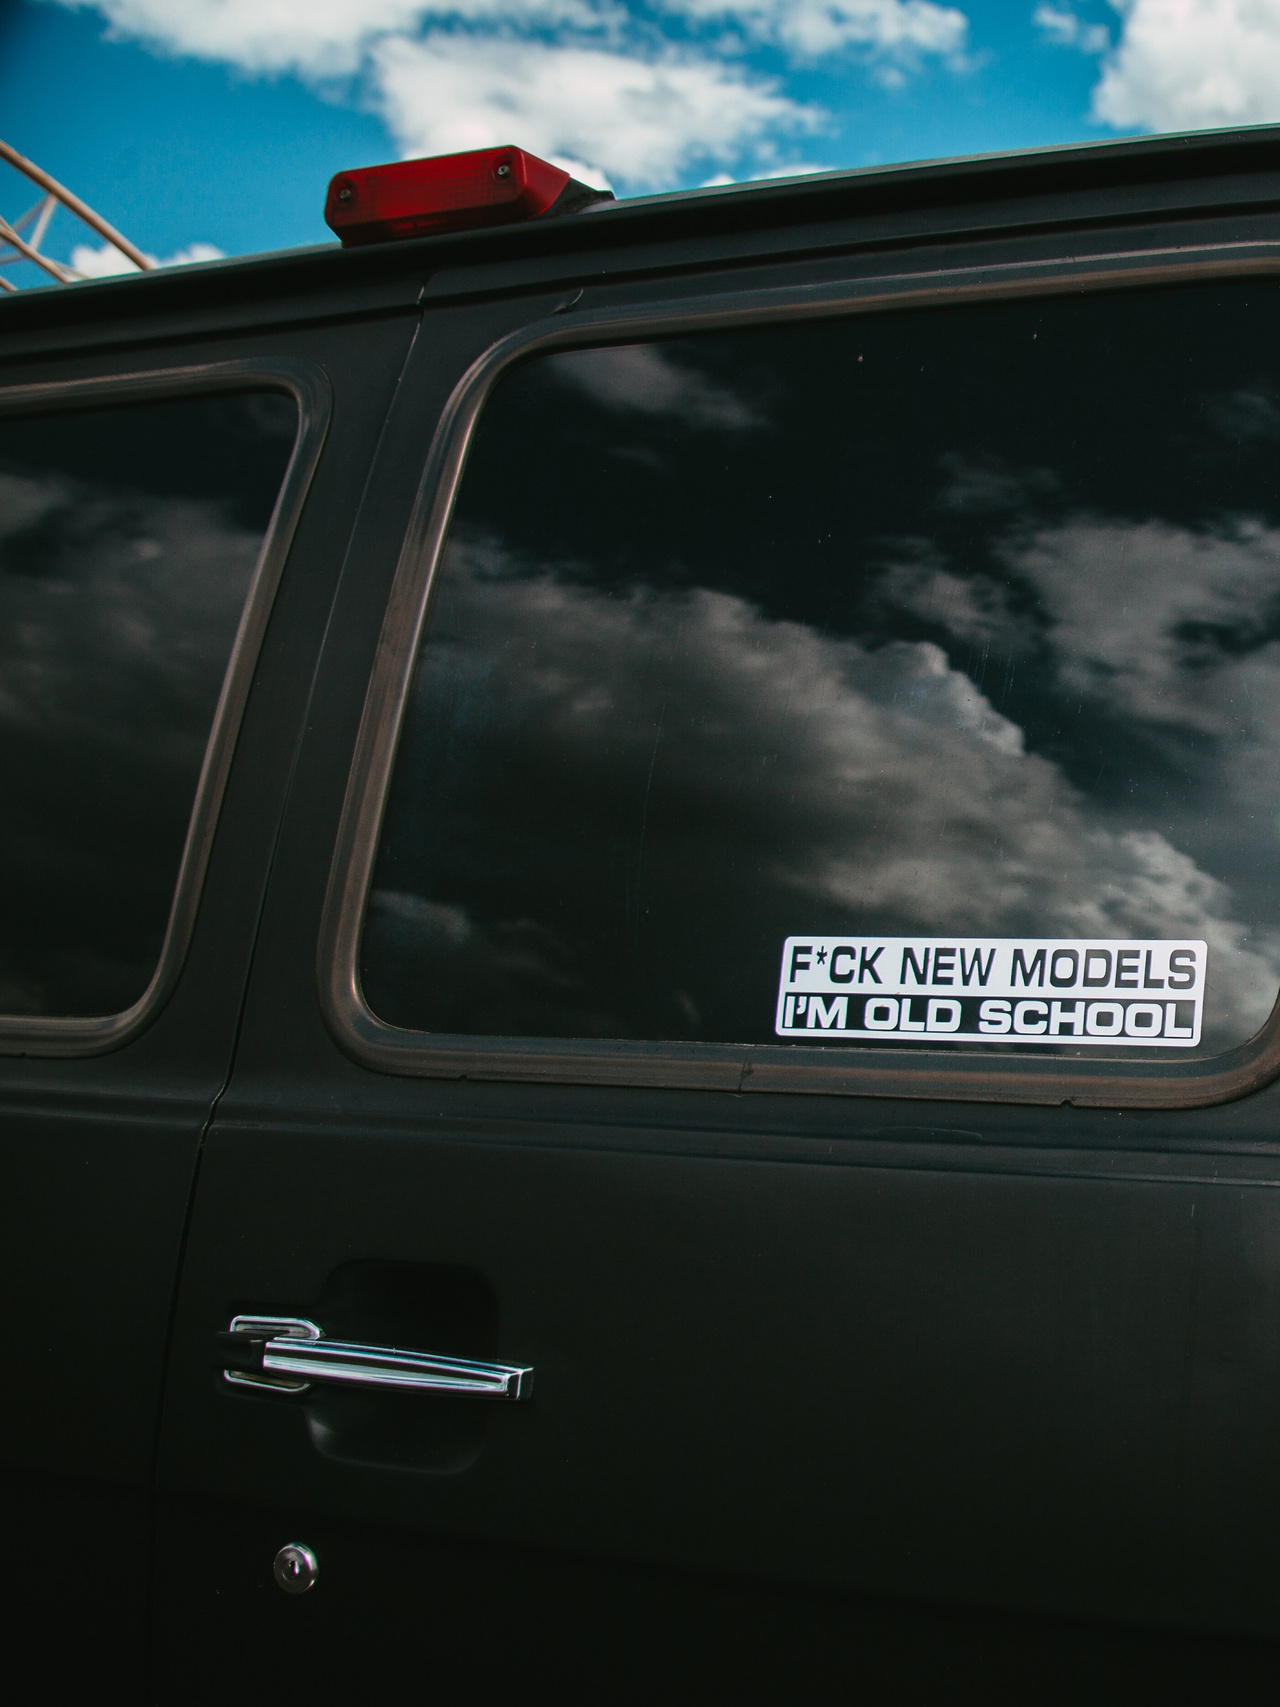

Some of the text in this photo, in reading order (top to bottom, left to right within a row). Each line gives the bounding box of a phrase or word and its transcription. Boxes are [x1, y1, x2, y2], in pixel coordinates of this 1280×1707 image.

[900, 947, 997, 987] NEW
[1010, 948, 1197, 990] MODELS
[784, 995, 1193, 1038] I'M OLD SCHOOL
